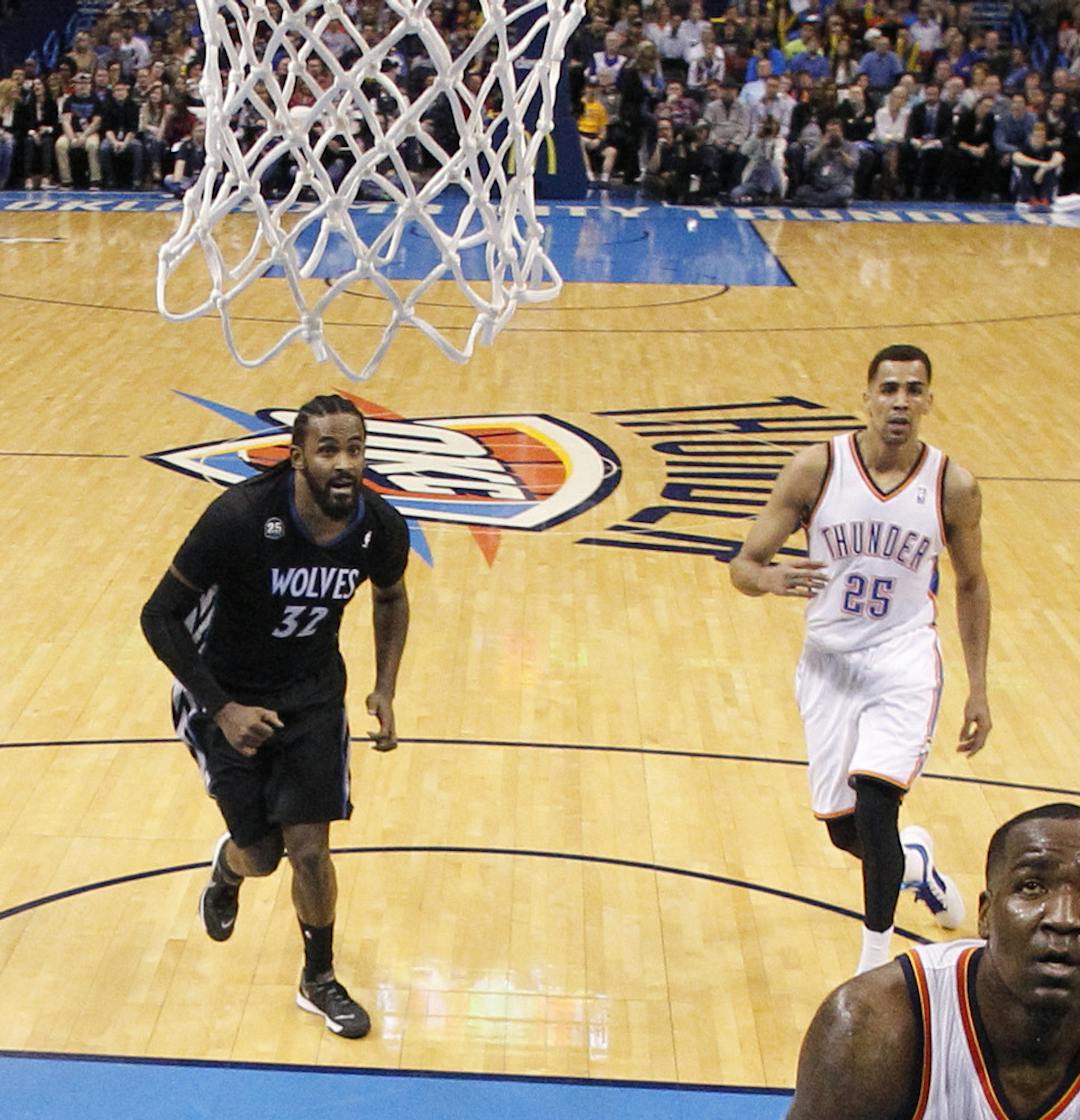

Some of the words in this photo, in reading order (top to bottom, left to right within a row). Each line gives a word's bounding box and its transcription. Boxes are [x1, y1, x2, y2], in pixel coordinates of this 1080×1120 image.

[821, 520, 931, 573] THUNDER
[270, 567, 360, 600] WOLVES
[840, 571, 896, 621] 25
[271, 605, 329, 639] 32
